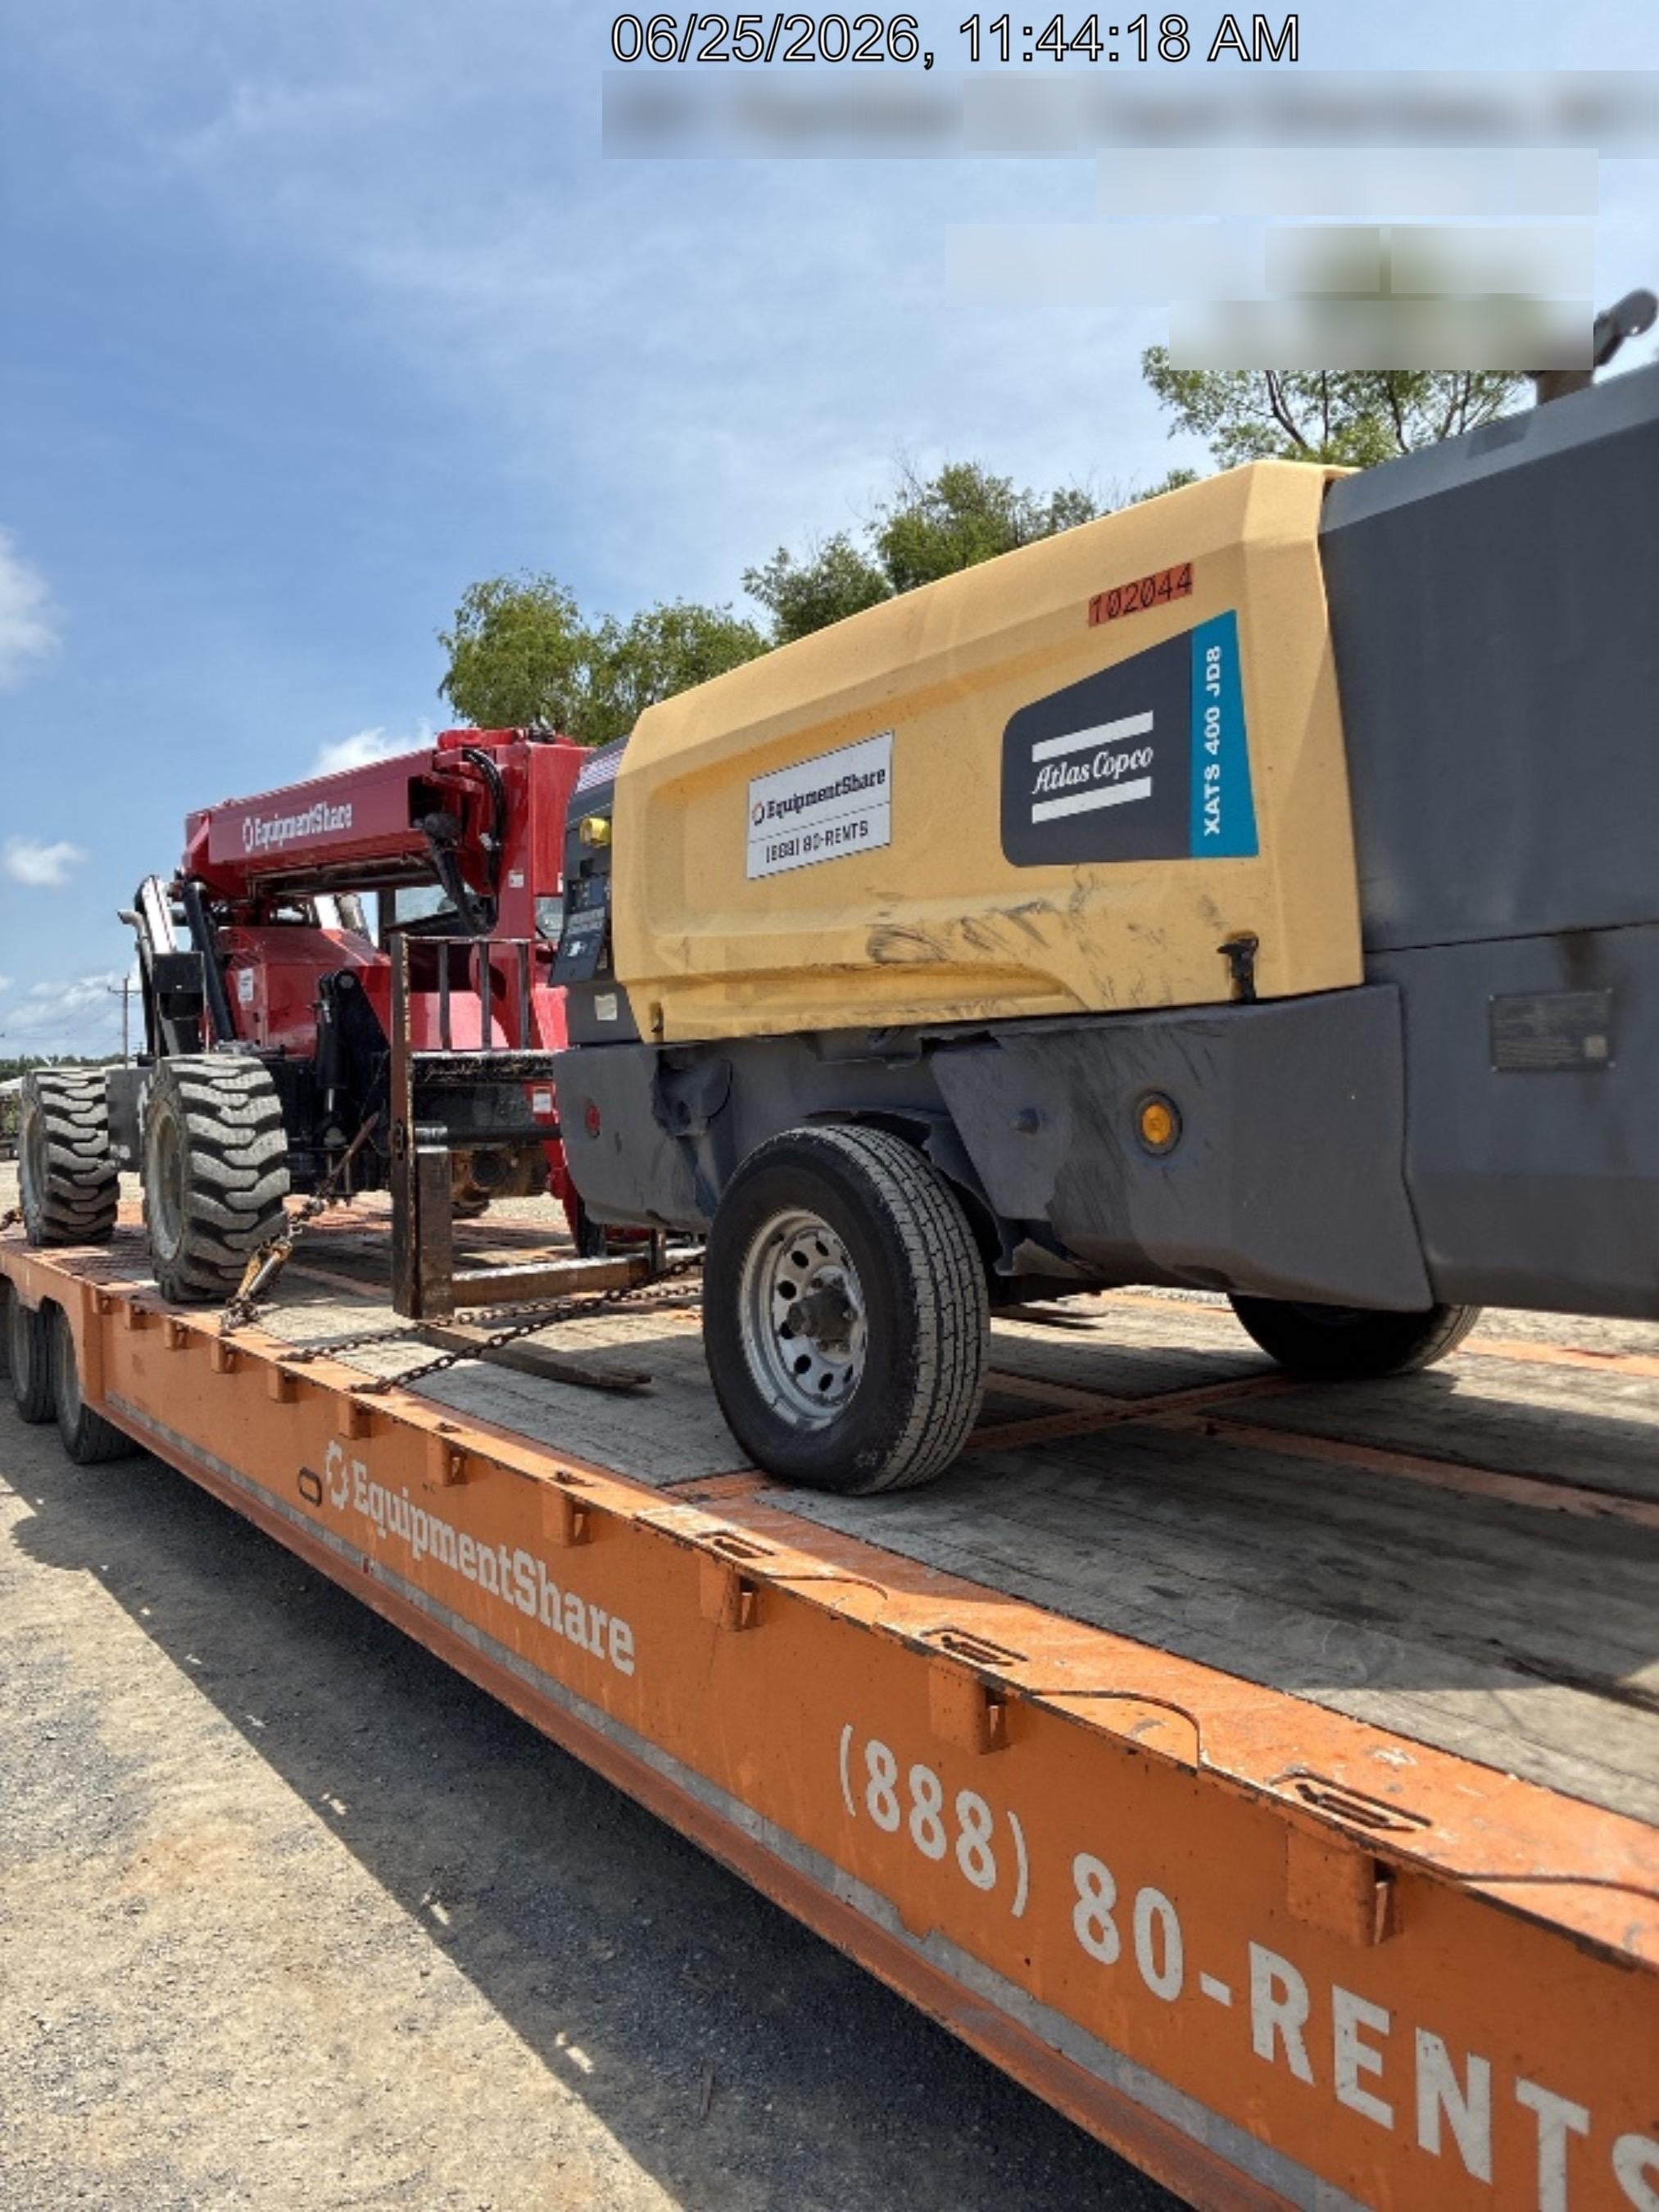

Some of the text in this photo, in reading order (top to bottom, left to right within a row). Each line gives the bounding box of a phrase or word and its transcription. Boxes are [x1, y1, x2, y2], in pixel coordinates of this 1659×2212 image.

[1093, 563, 1192, 623] 102044
[1203, 646, 1222, 836] XATS 400 JD8
[766, 768, 886, 818] EquipmentShare
[1031, 746, 1154, 795] Atlas Copco
[255, 801, 352, 850] EquipmentShare
[803, 820, 868, 852] 80-RENTS
[351, 1460, 635, 1676] EquipmentShare
[840, 1724, 1030, 1918] (888)
